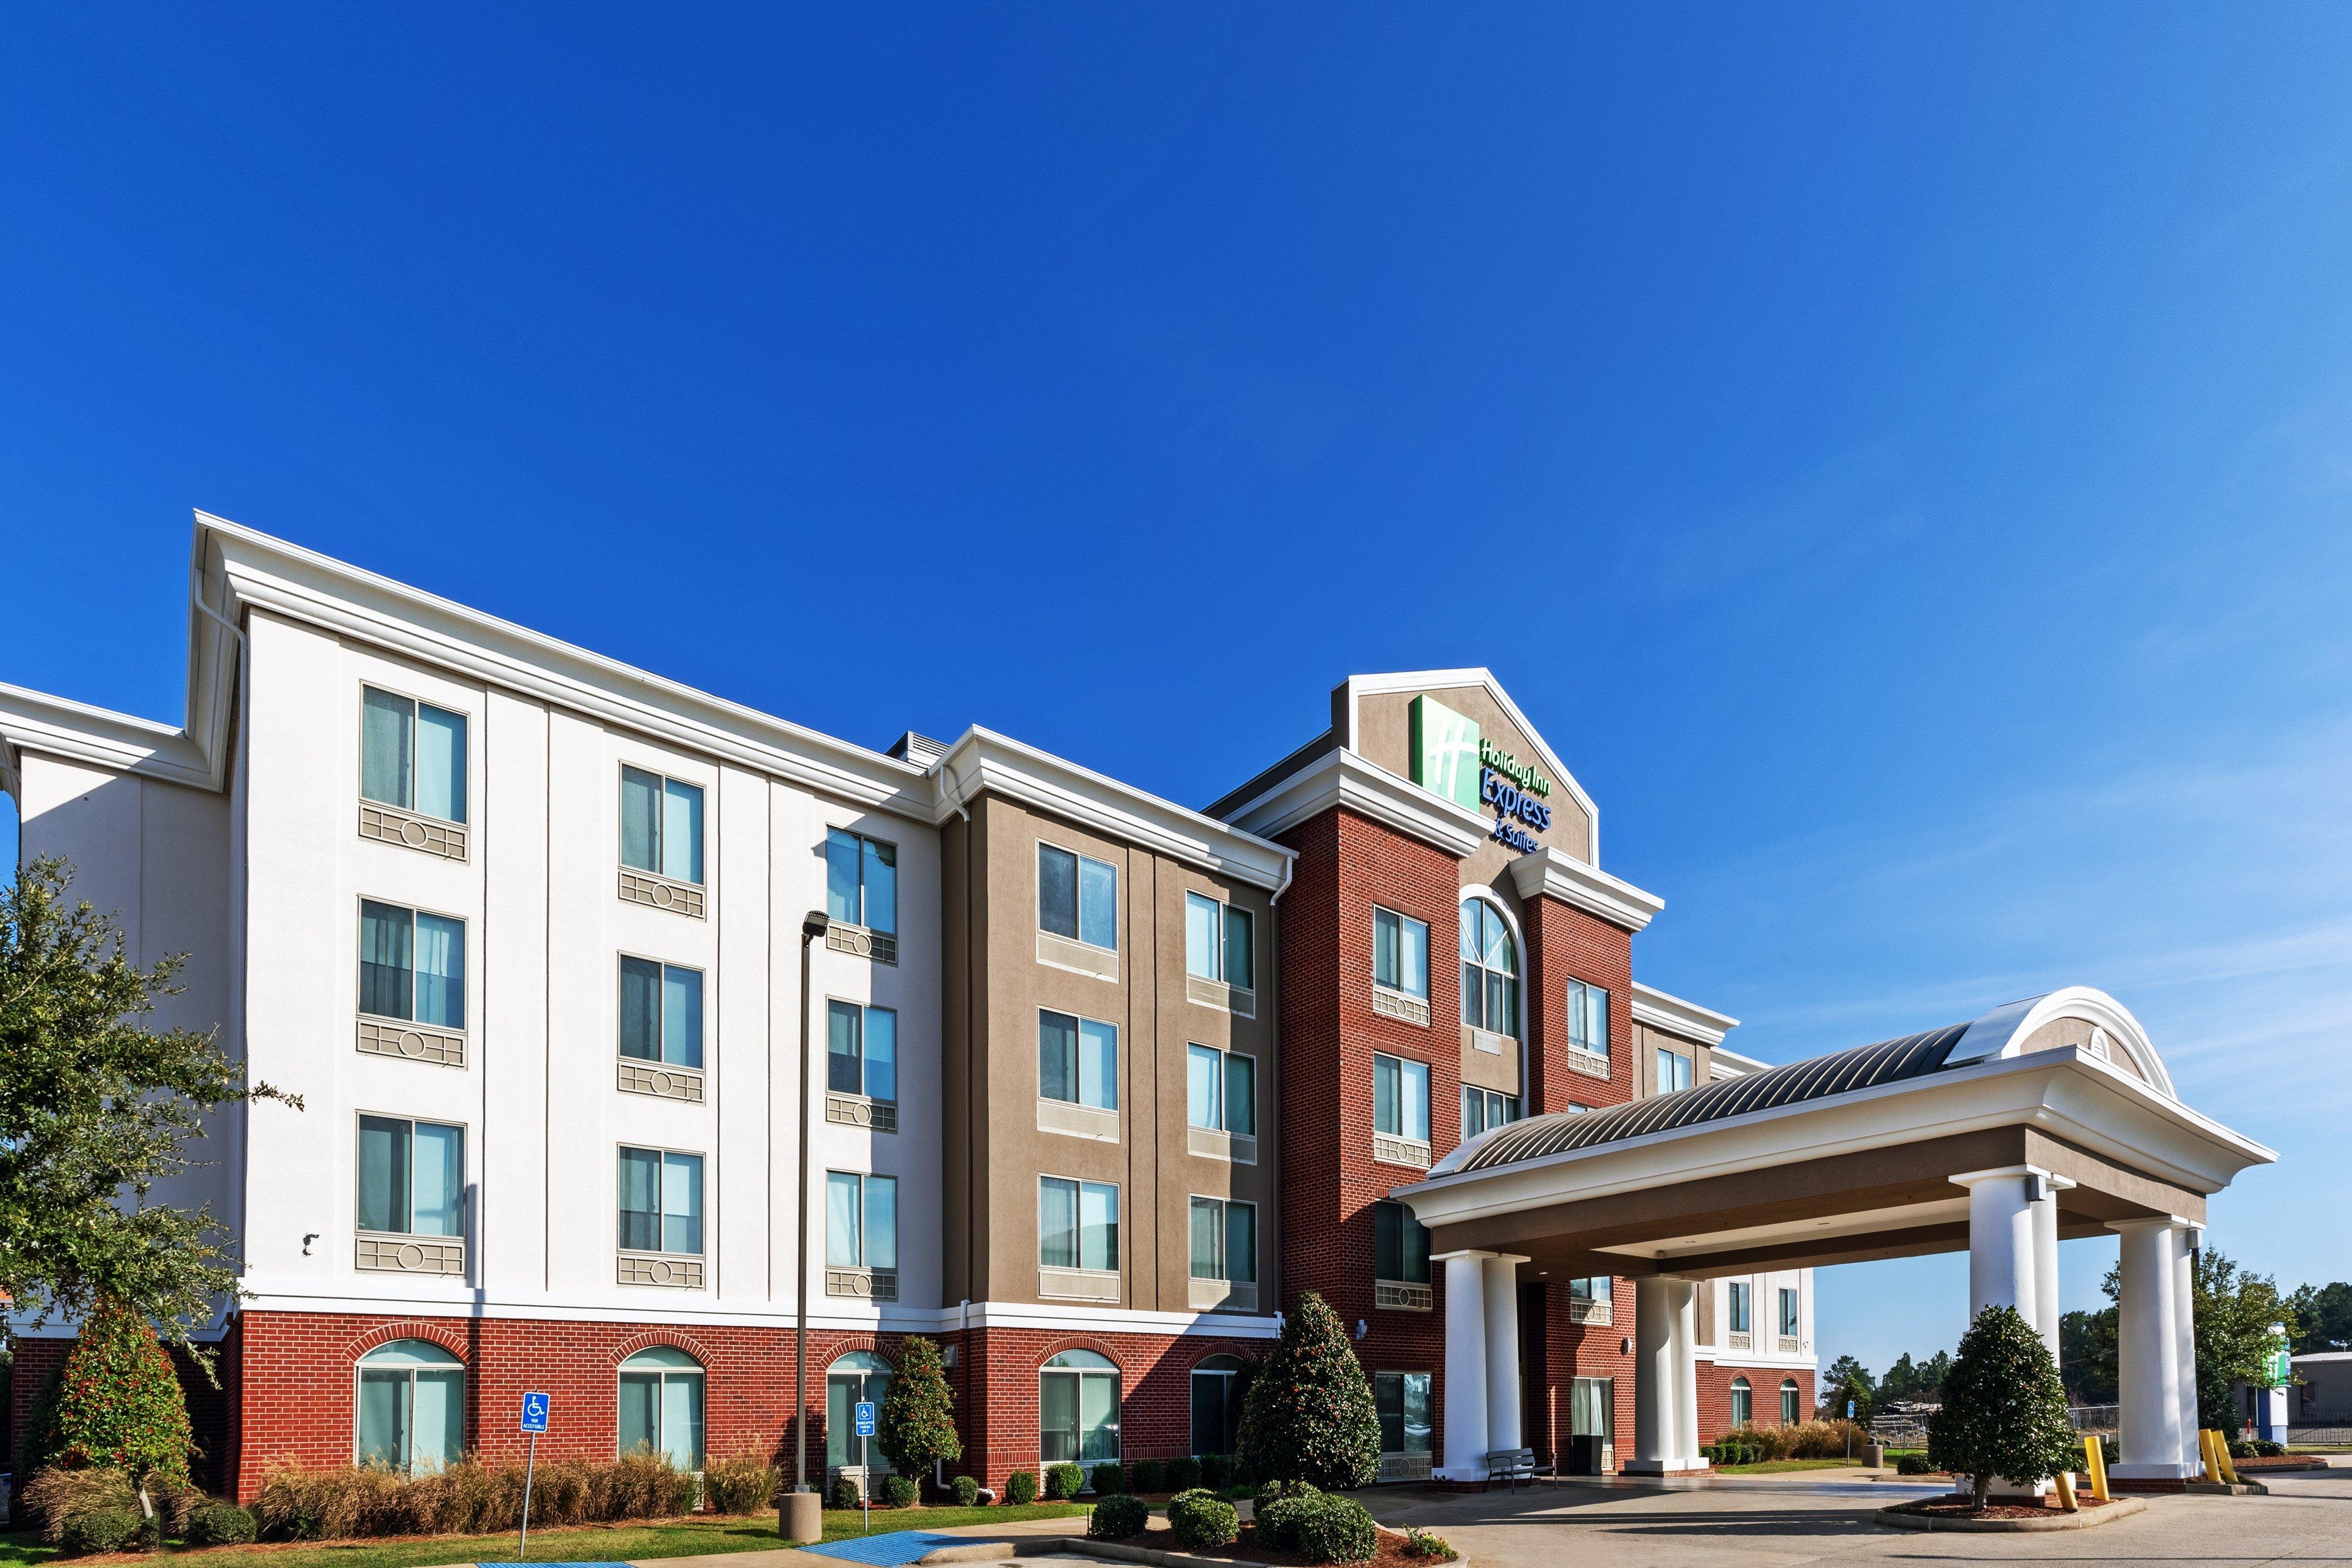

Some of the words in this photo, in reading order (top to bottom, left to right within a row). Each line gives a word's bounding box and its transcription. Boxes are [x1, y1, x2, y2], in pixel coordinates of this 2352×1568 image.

[1482, 737, 1531, 788] Holiday
[1532, 765, 1551, 795] Inn
[1482, 767, 1551, 829] Express
[1495, 817, 1504, 840] &
[1505, 823, 1539, 853] Suites
